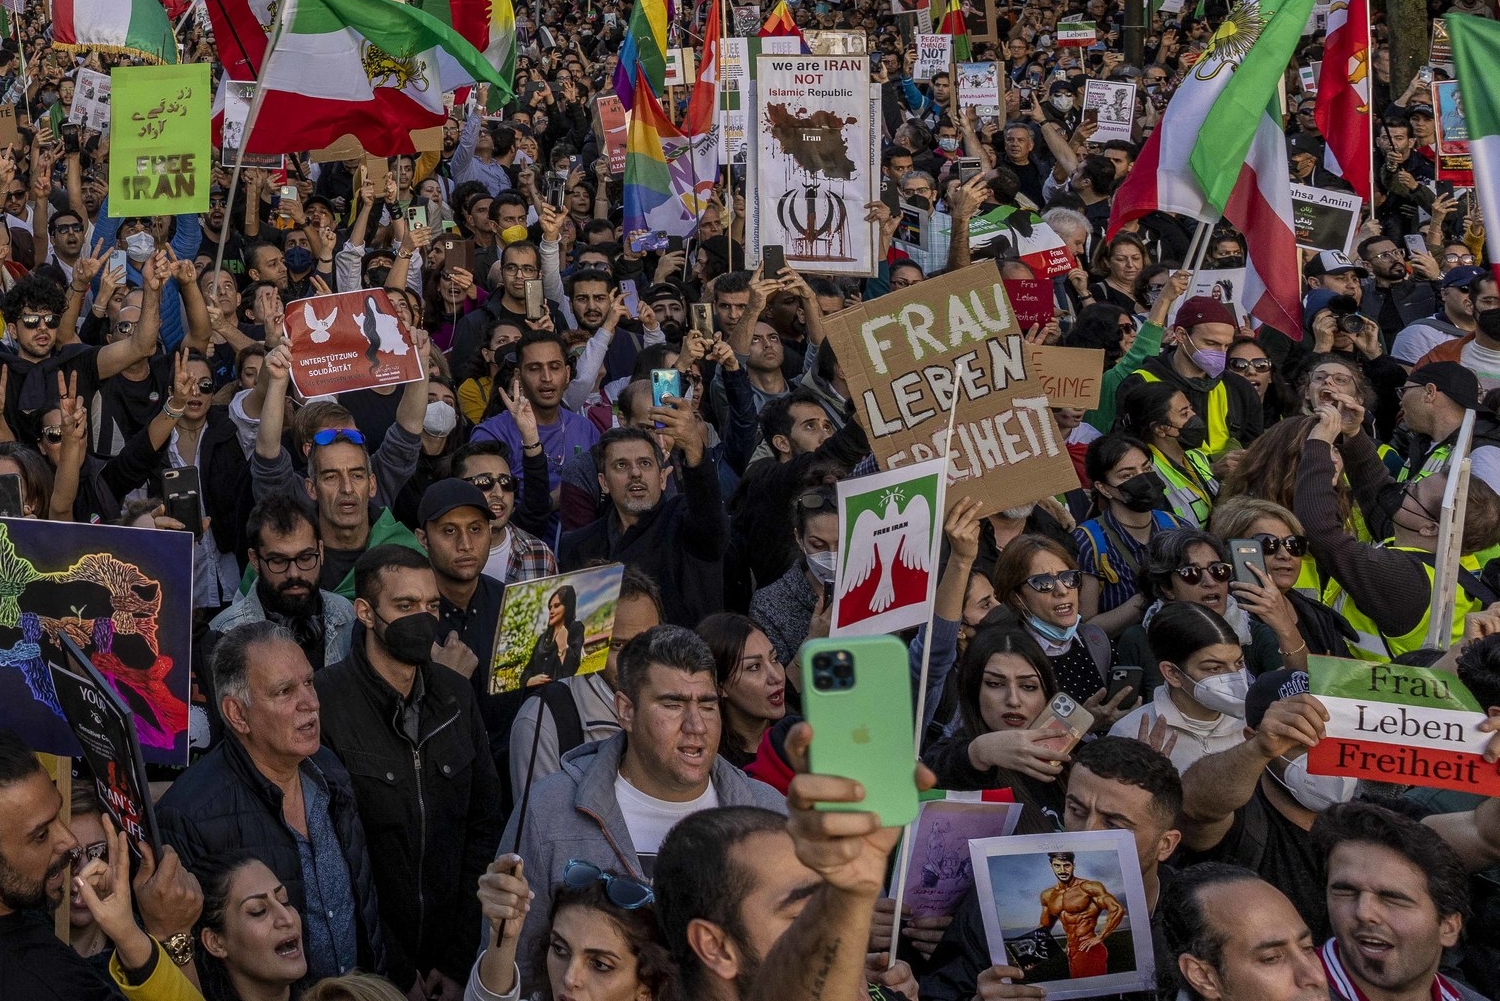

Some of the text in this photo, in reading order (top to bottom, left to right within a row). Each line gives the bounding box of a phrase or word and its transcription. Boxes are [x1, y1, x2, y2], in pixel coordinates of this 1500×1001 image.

[921, 48, 947, 61] NOT
[772, 59, 862, 71] we are IRAN
[794, 74, 824, 85] NOT
[768, 88, 853, 98] Islamic Republic
[802, 133, 821, 142] Iran
[136, 153, 196, 175] FREE
[122, 173, 195, 200] IRAN
[1295, 217, 1312, 225] زندگی
[1049, 249, 1064, 258] Frau
[1049, 256, 1069, 266] Leben
[1046, 262, 1072, 274] Freiheit
[1020, 281, 1038, 289] Frau
[1016, 293, 1039, 302] Leben
[862, 283, 1011, 374] FRAU
[300, 351, 358, 367] UNTERSTÜTZUNG
[308, 364, 352, 377] SOLIDARITÄT
[862, 334, 1027, 439] LEBEN
[873, 521, 909, 537] FREE IRAN
[1368, 665, 1454, 700] Frau
[79, 685, 107, 713] YOUR
[1355, 704, 1466, 743] Leben
[1336, 742, 1481, 784] Freiheit
